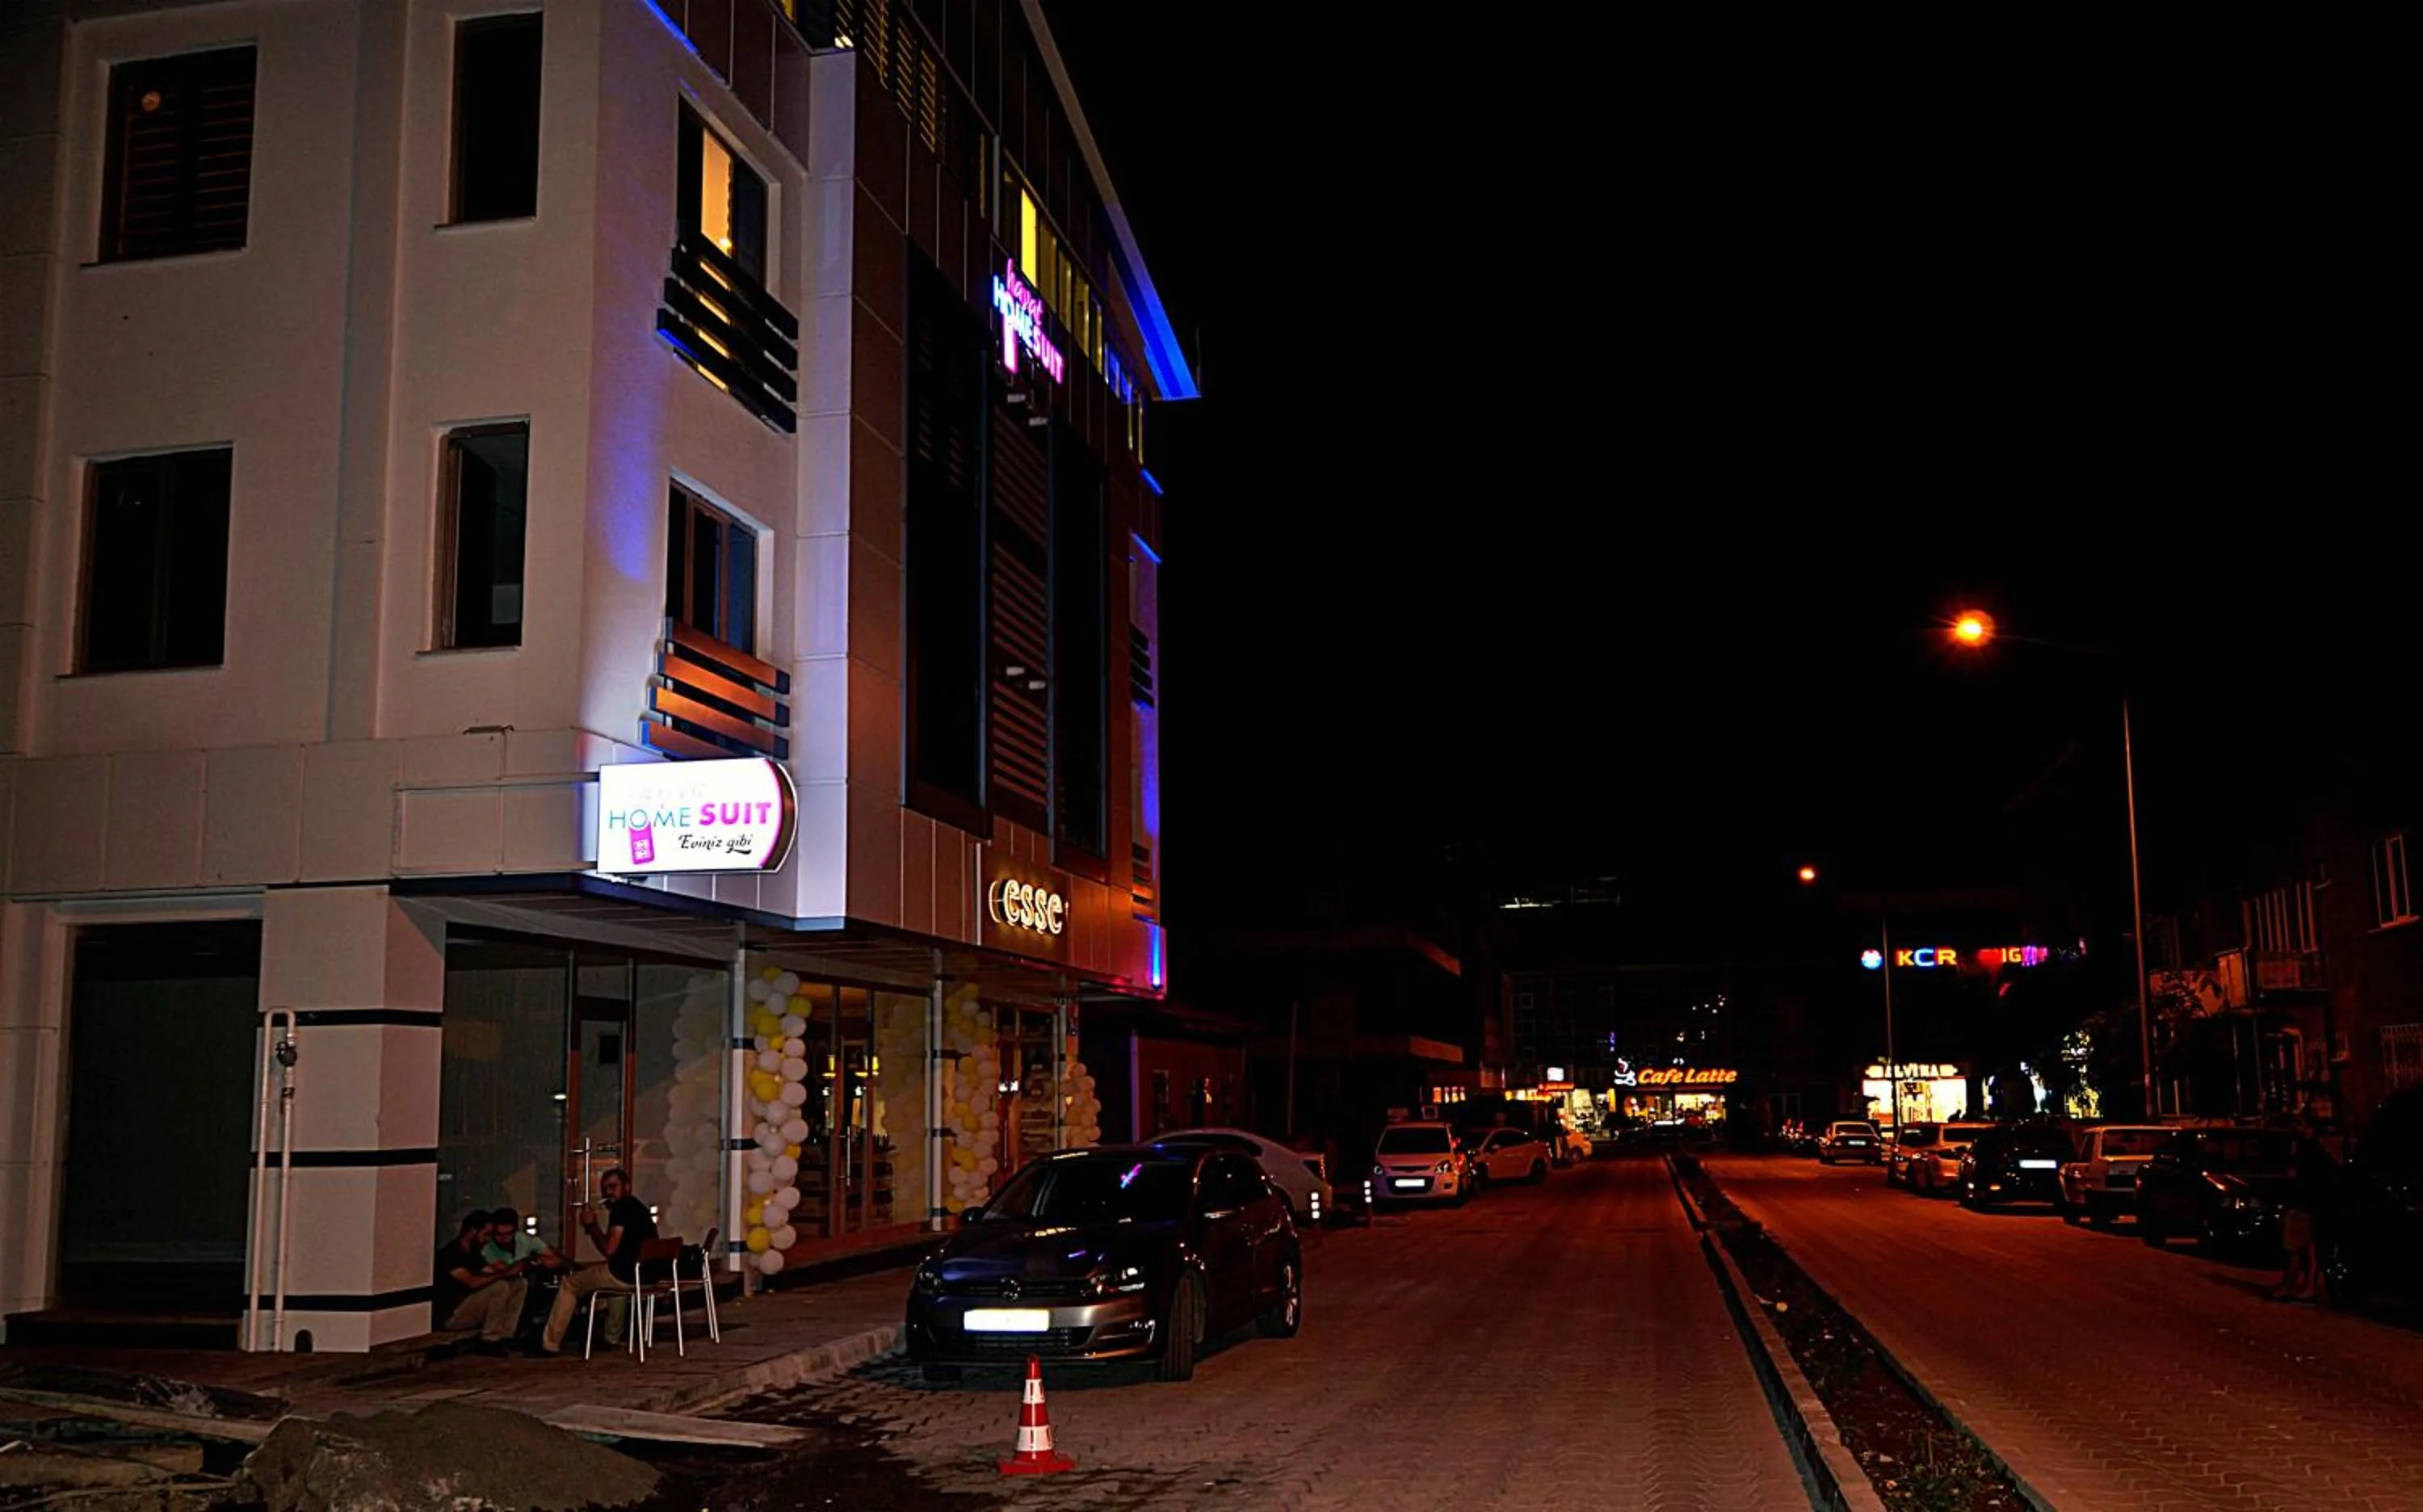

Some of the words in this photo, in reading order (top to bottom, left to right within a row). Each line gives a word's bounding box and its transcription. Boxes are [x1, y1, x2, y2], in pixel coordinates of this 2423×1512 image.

[1033, 325, 1064, 384] SUIT
[608, 807, 691, 830] HOME
[699, 801, 772, 826] SUIT
[1895, 947, 1958, 967] KCR
[1637, 1068, 1684, 1085] Cafe
[1684, 1067, 1738, 1084] Latte
